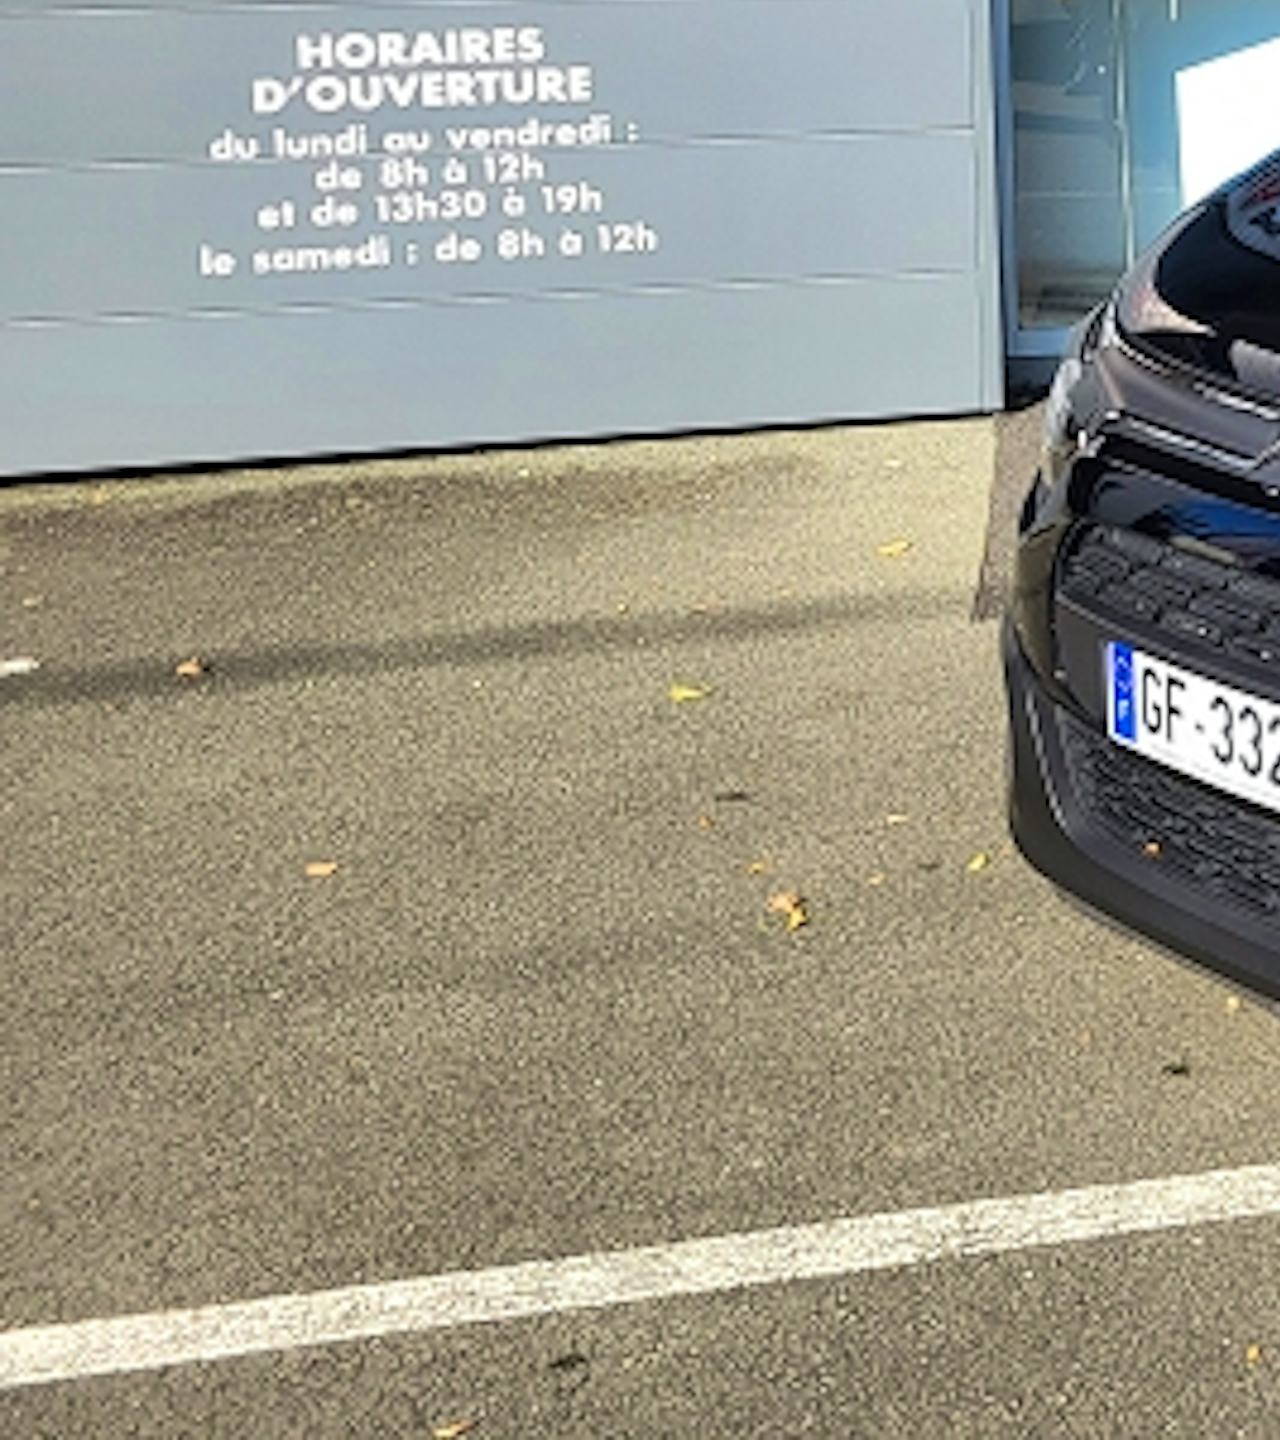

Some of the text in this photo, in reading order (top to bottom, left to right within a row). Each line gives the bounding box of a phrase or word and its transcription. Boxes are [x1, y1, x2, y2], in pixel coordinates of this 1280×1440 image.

[296, 26, 545, 70] HORAIRES
[252, 66, 593, 113] D'OUVERTURE
[208, 128, 258, 161] du
[274, 124, 367, 157] lundi
[383, 128, 430, 153] au
[446, 113, 612, 150] vendredi
[315, 153, 545, 191] de 8h à 12h
[257, 183, 603, 230] et de 13h30 à 19h
[199, 244, 236, 277] le
[252, 235, 391, 274] samedi
[435, 232, 482, 263] de
[498, 228, 545, 259] 8h
[559, 227, 583, 258] à
[597, 223, 658, 254] 12h
